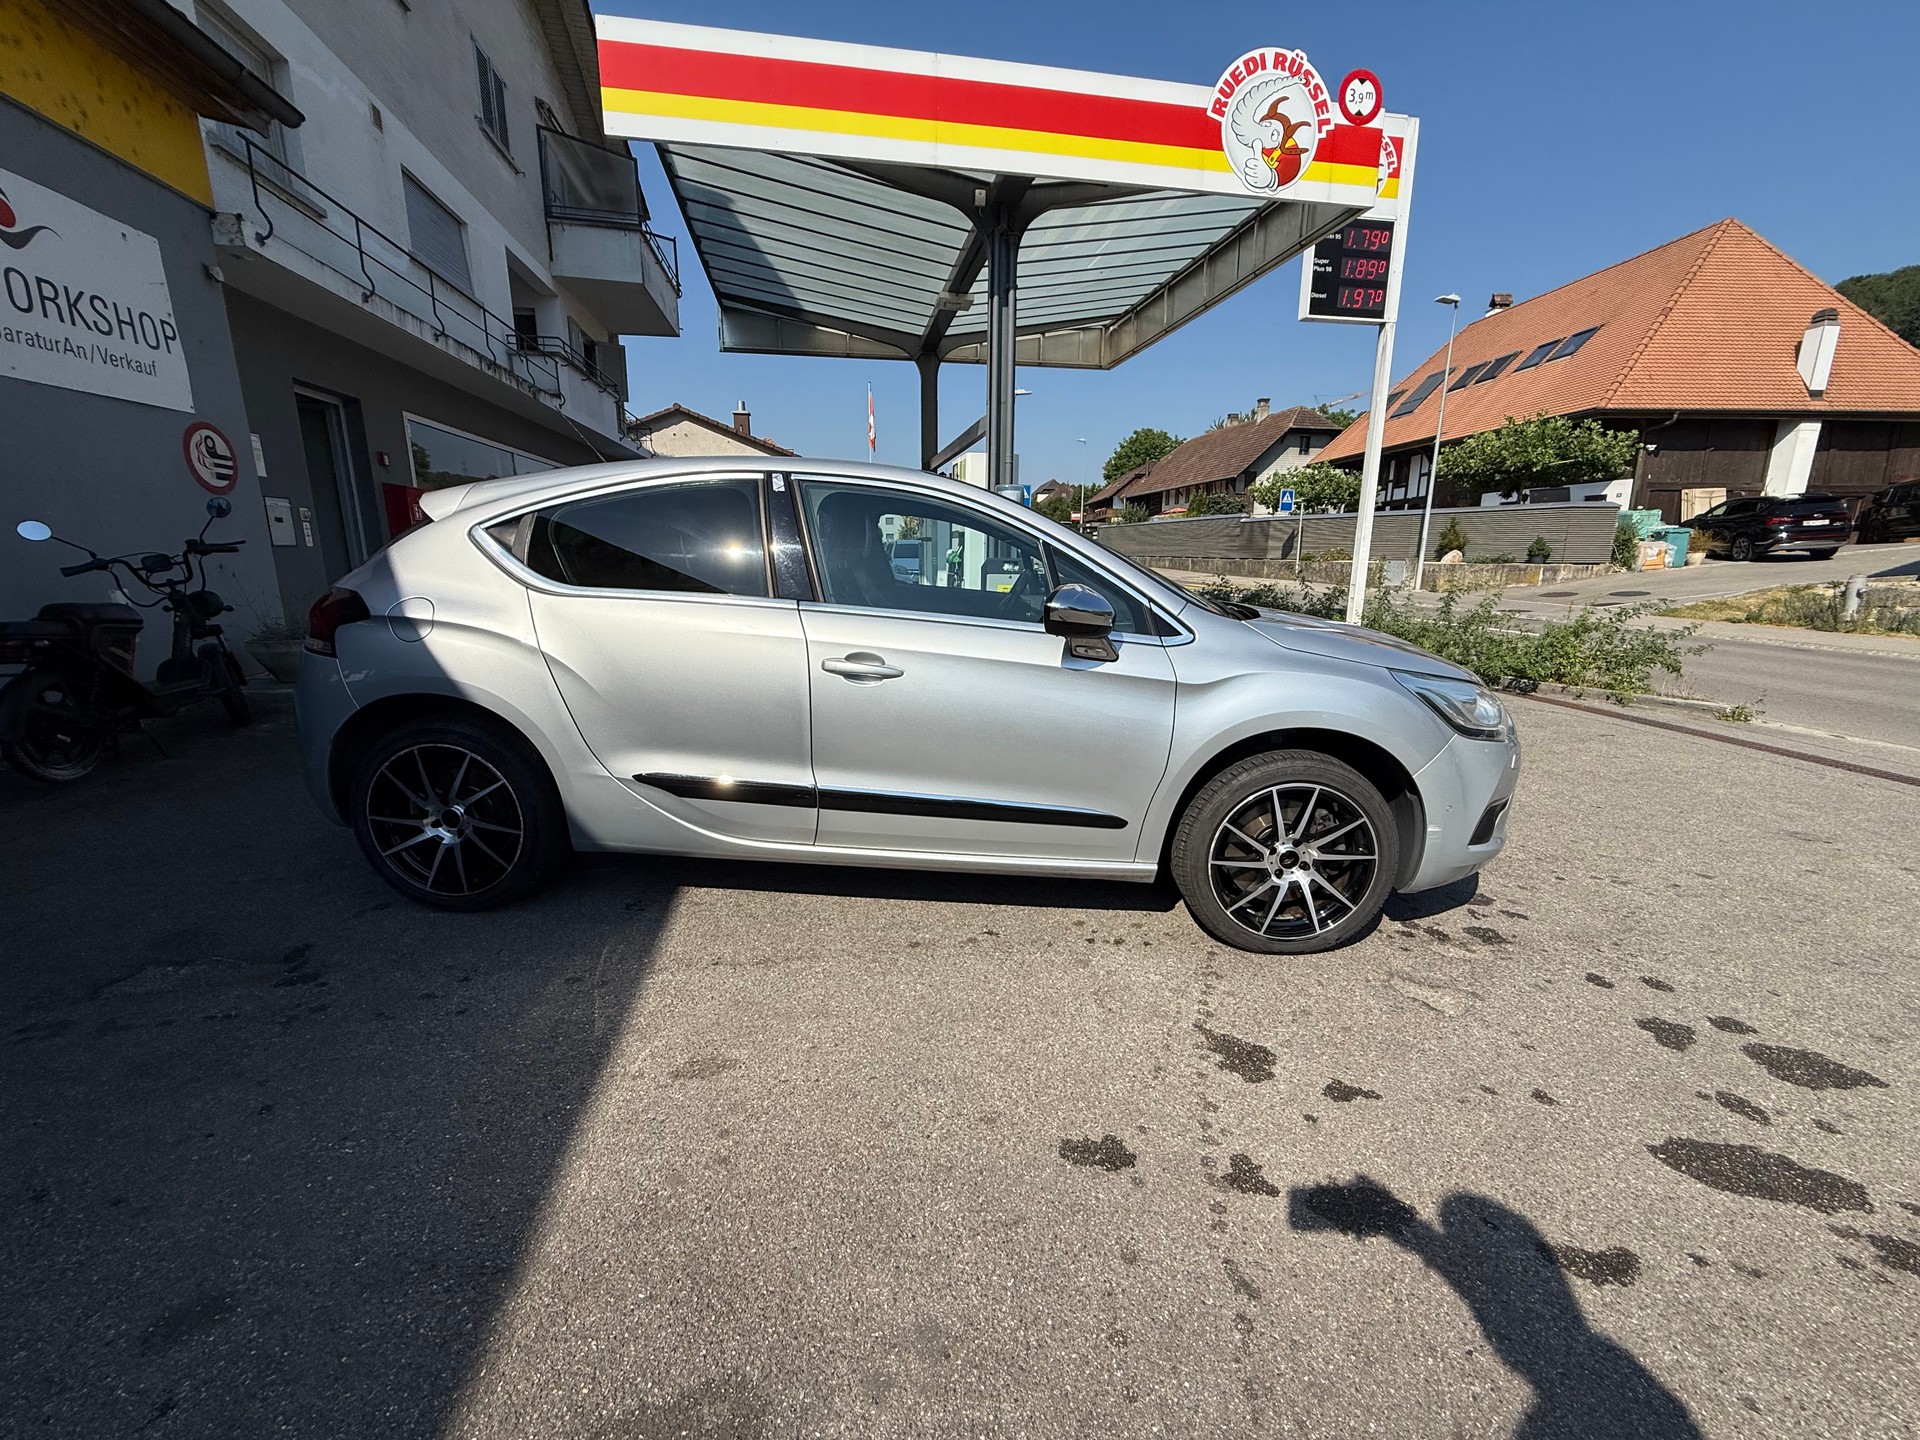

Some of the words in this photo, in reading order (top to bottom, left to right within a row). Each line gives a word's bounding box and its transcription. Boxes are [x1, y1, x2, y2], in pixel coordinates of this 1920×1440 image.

[1211, 52, 1268, 118] RUEDI
[1272, 51, 1331, 134] RÜSSEL
[1348, 88, 1364, 104] 3,9
[1365, 91, 1374, 101] m
[1381, 135, 1395, 171] SEL
[3, 266, 178, 354] ORKSHOP
[0, 326, 158, 378] araturAn/Verkauf
